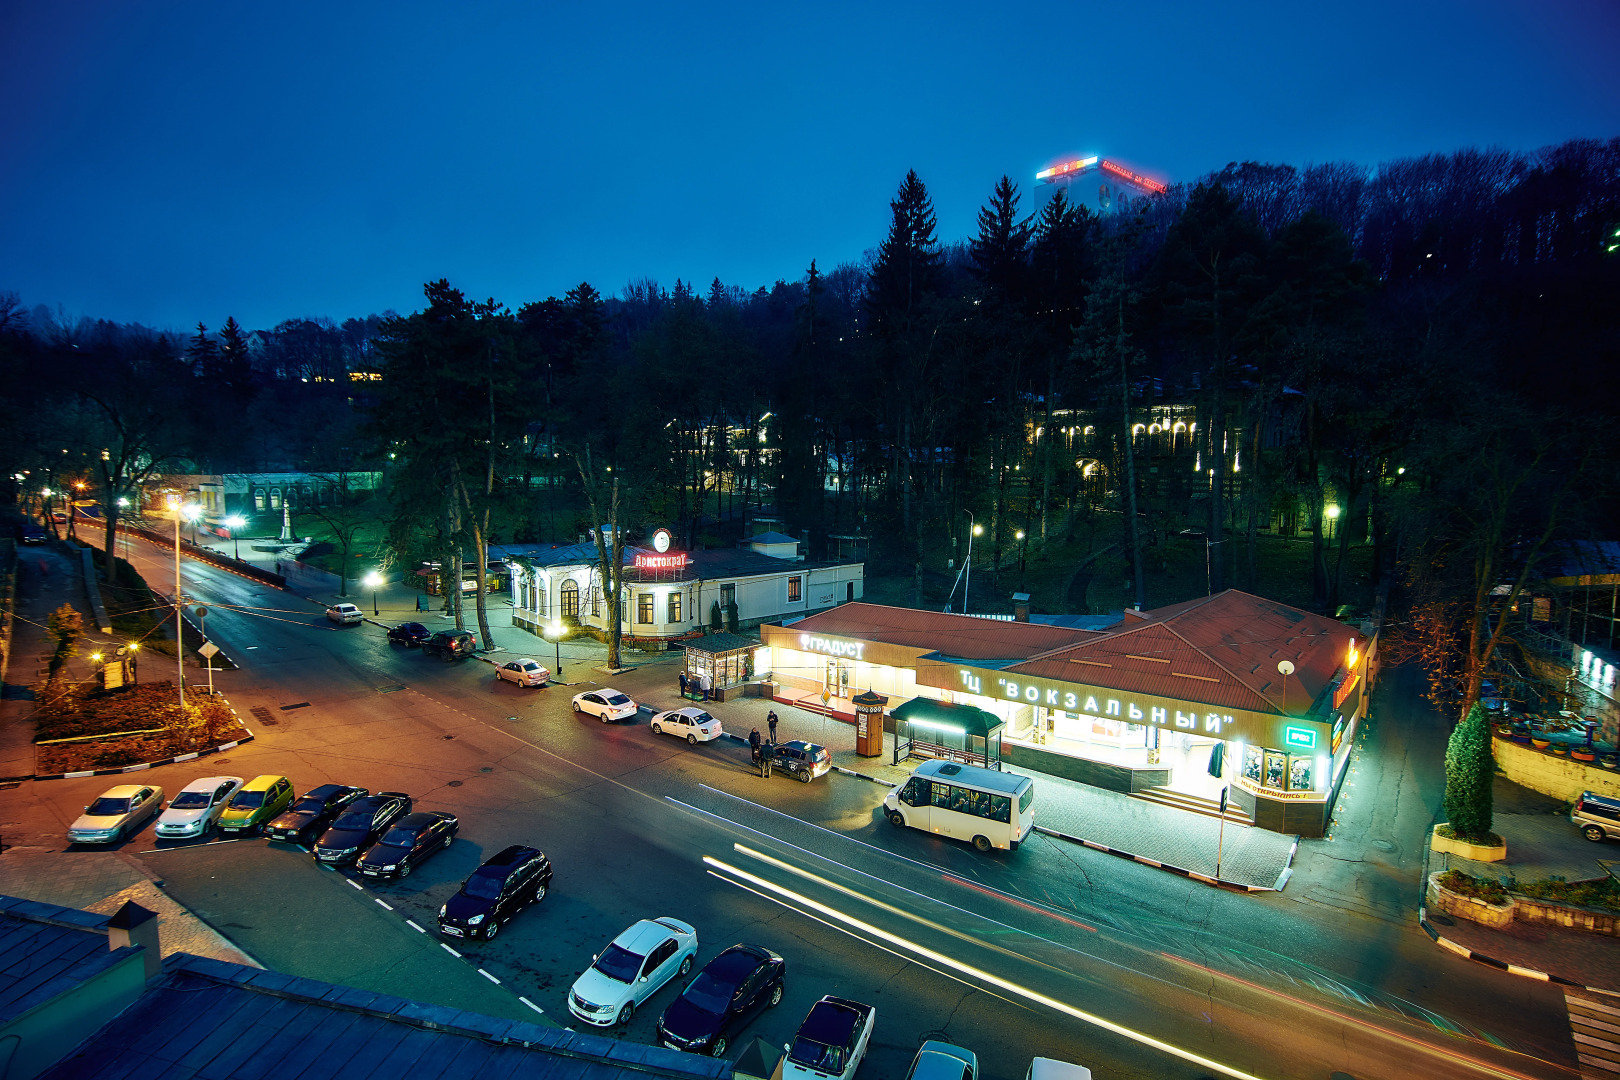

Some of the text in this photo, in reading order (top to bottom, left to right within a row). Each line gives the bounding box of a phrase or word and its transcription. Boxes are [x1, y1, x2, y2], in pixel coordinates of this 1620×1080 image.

[635, 553, 686, 567] Аристократ
[810, 637, 856, 656] ГРАДУС
[960, 670, 1233, 733] ТЦ “ВОКЗАЛЬНЫЙ”
